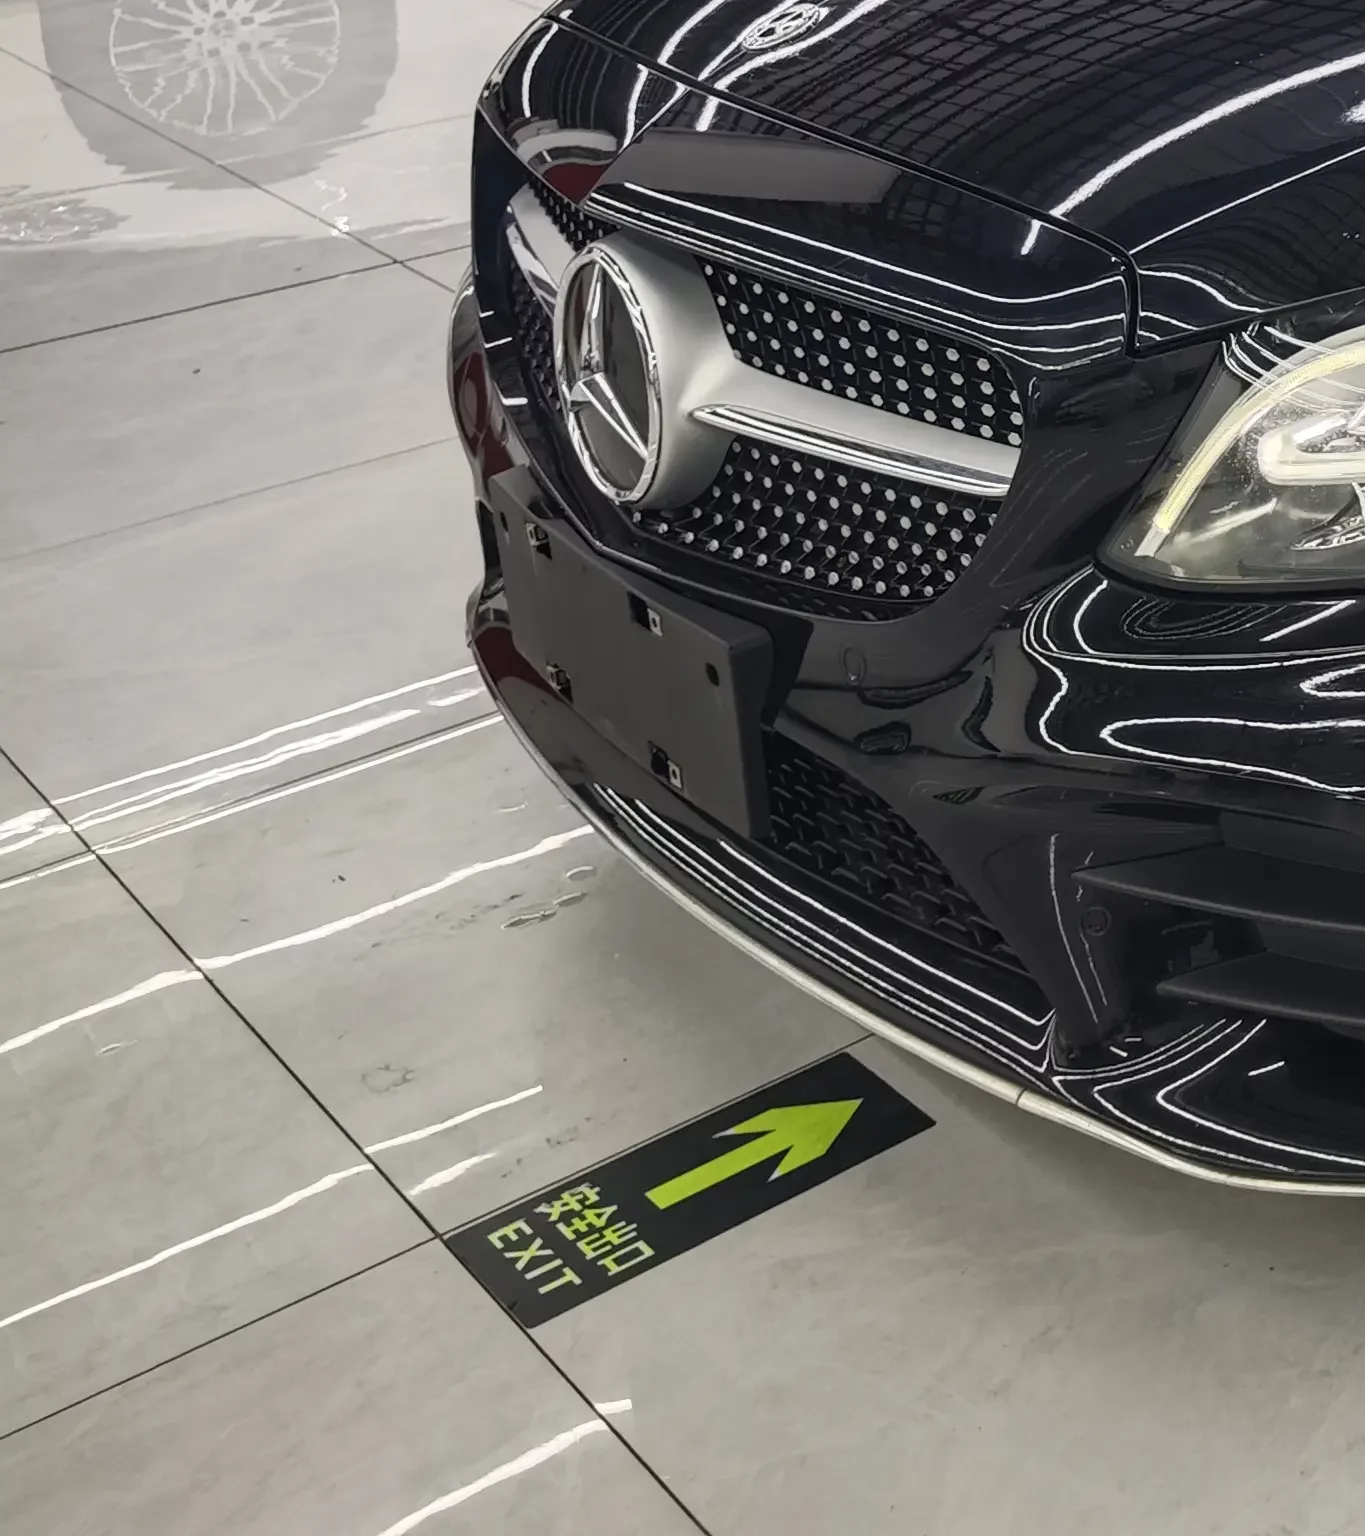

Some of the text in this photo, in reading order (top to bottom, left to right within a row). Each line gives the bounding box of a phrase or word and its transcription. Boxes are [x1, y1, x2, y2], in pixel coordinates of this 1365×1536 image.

[486, 1217, 583, 1295] EXIT
[532, 1181, 656, 1277] 安全出口
